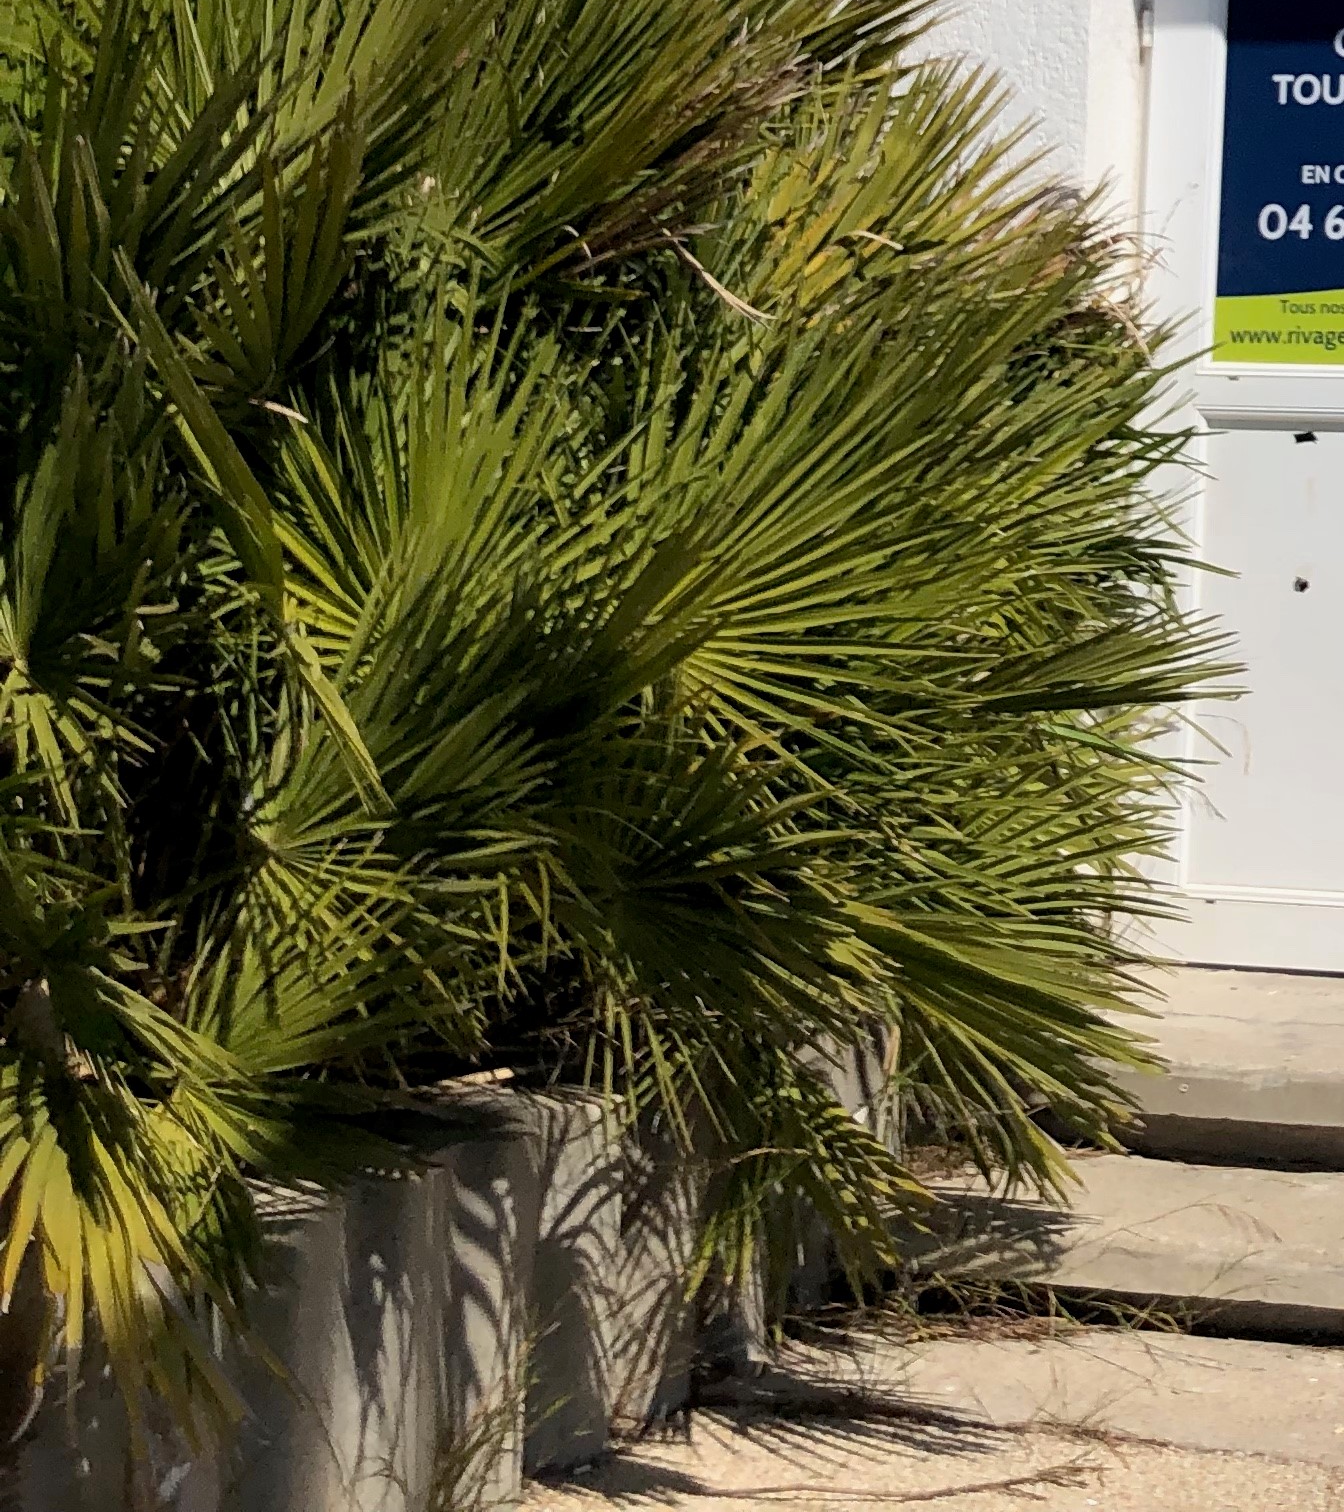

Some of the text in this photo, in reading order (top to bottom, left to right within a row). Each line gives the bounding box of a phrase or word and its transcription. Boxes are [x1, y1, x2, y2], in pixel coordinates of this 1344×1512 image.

[1302, 165, 1330, 184] EN
[1258, 204, 1313, 240] 04
[1280, 300, 1316, 314] Tous
